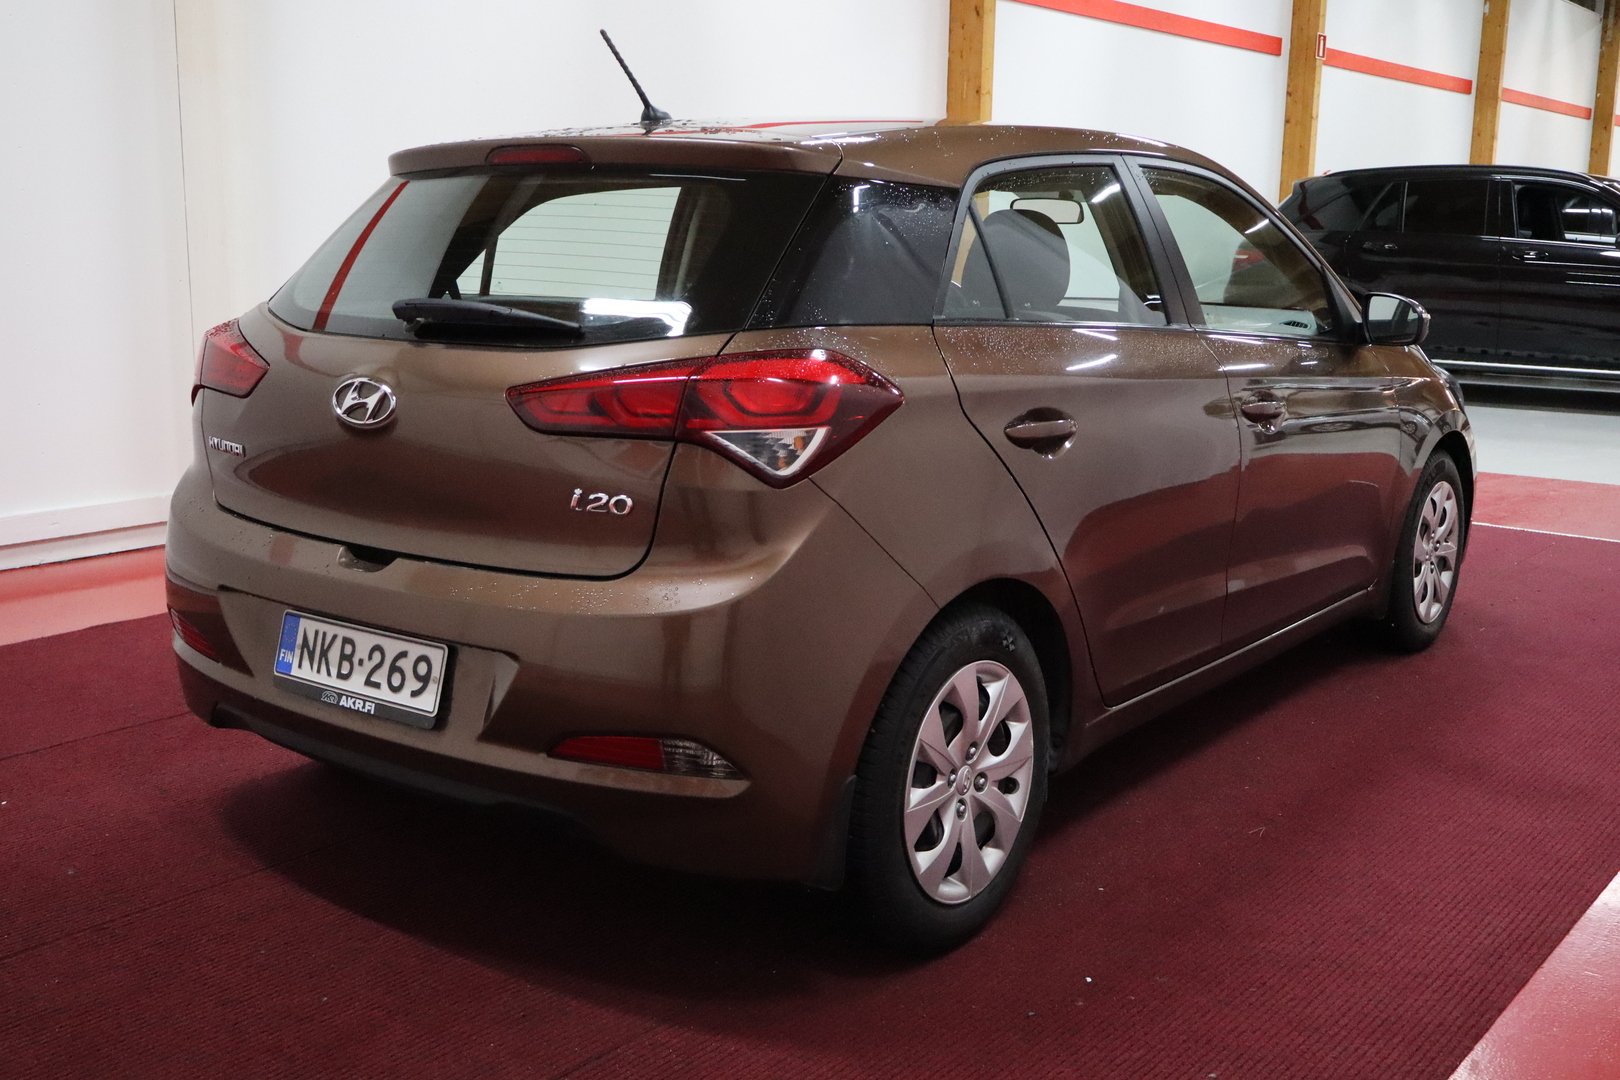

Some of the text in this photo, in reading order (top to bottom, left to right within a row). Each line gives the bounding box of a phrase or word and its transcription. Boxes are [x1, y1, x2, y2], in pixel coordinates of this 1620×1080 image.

[208, 435, 244, 456] HYUNDAI
[570, 488, 634, 516] i20
[278, 648, 294, 664] FIN
[338, 695, 376, 715] AKR.FI
